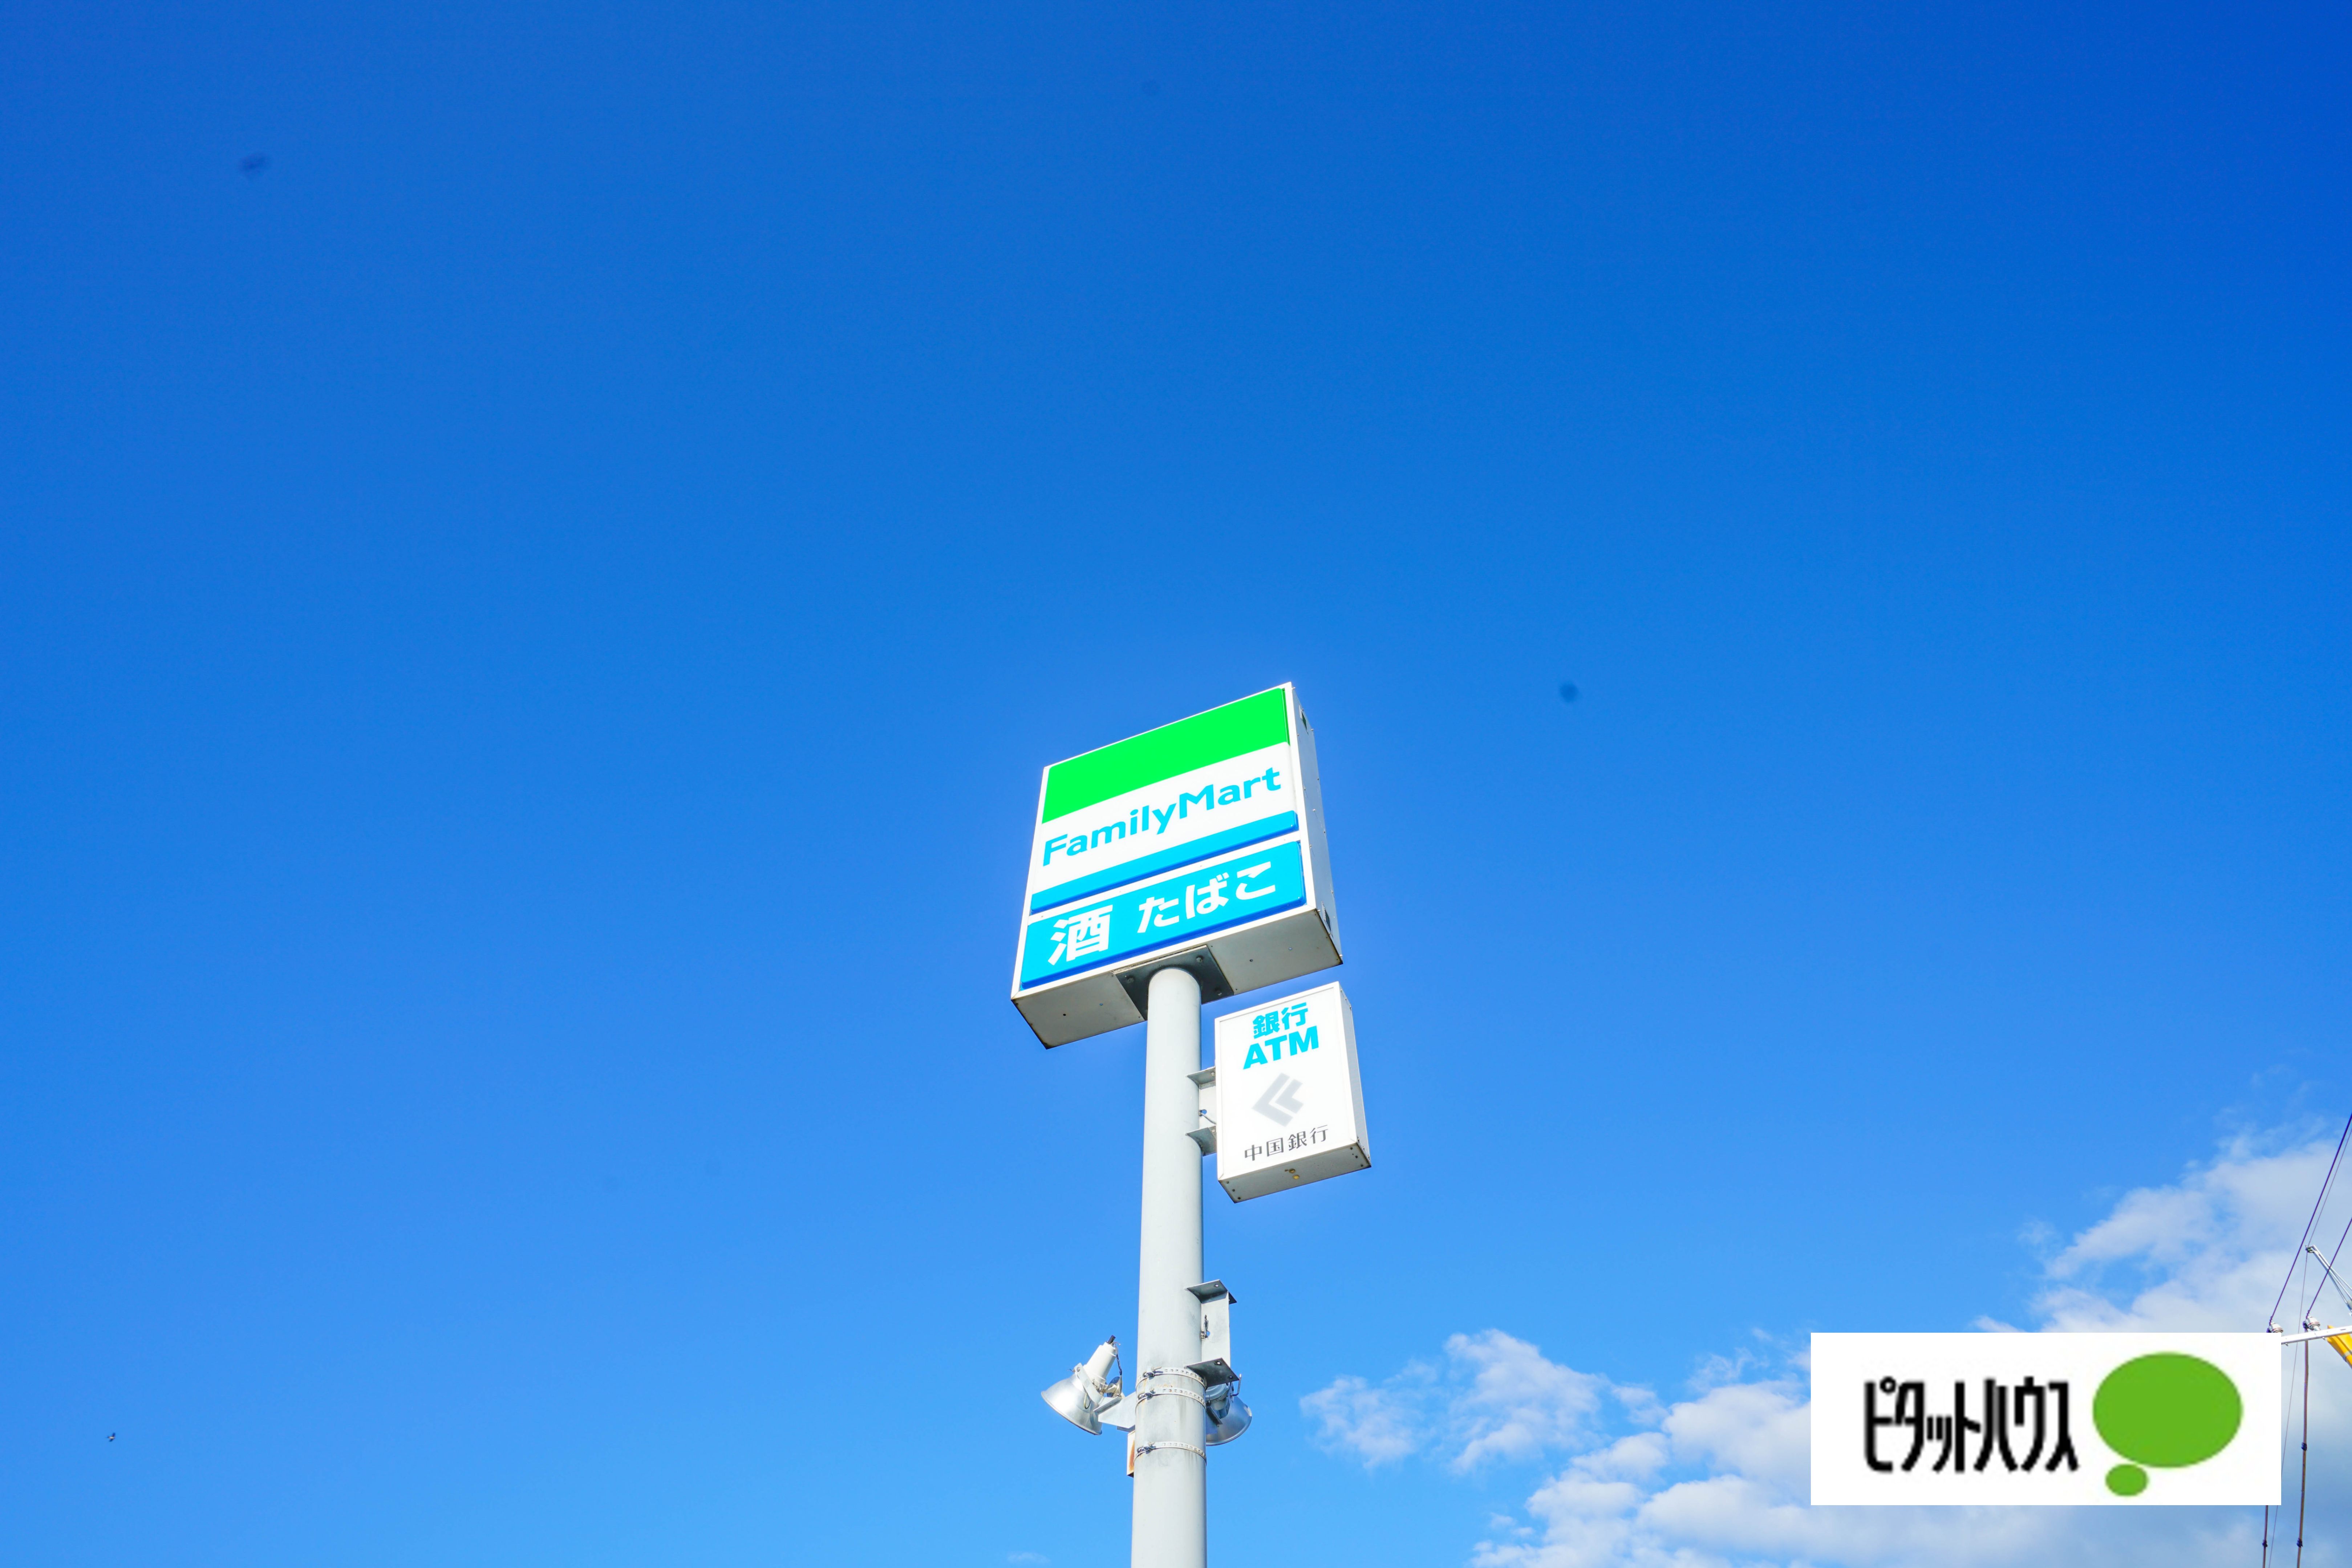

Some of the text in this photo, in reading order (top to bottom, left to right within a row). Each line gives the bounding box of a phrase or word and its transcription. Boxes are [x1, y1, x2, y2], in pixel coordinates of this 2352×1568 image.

[1043, 767, 1281, 866] FamilyMart
[1047, 861, 1276, 966] 酒 たばこ
[1253, 1002, 1308, 1039] 銀行
[1243, 1025, 1319, 1070] ATM
[1244, 1124, 1329, 1161] 中国銀行
